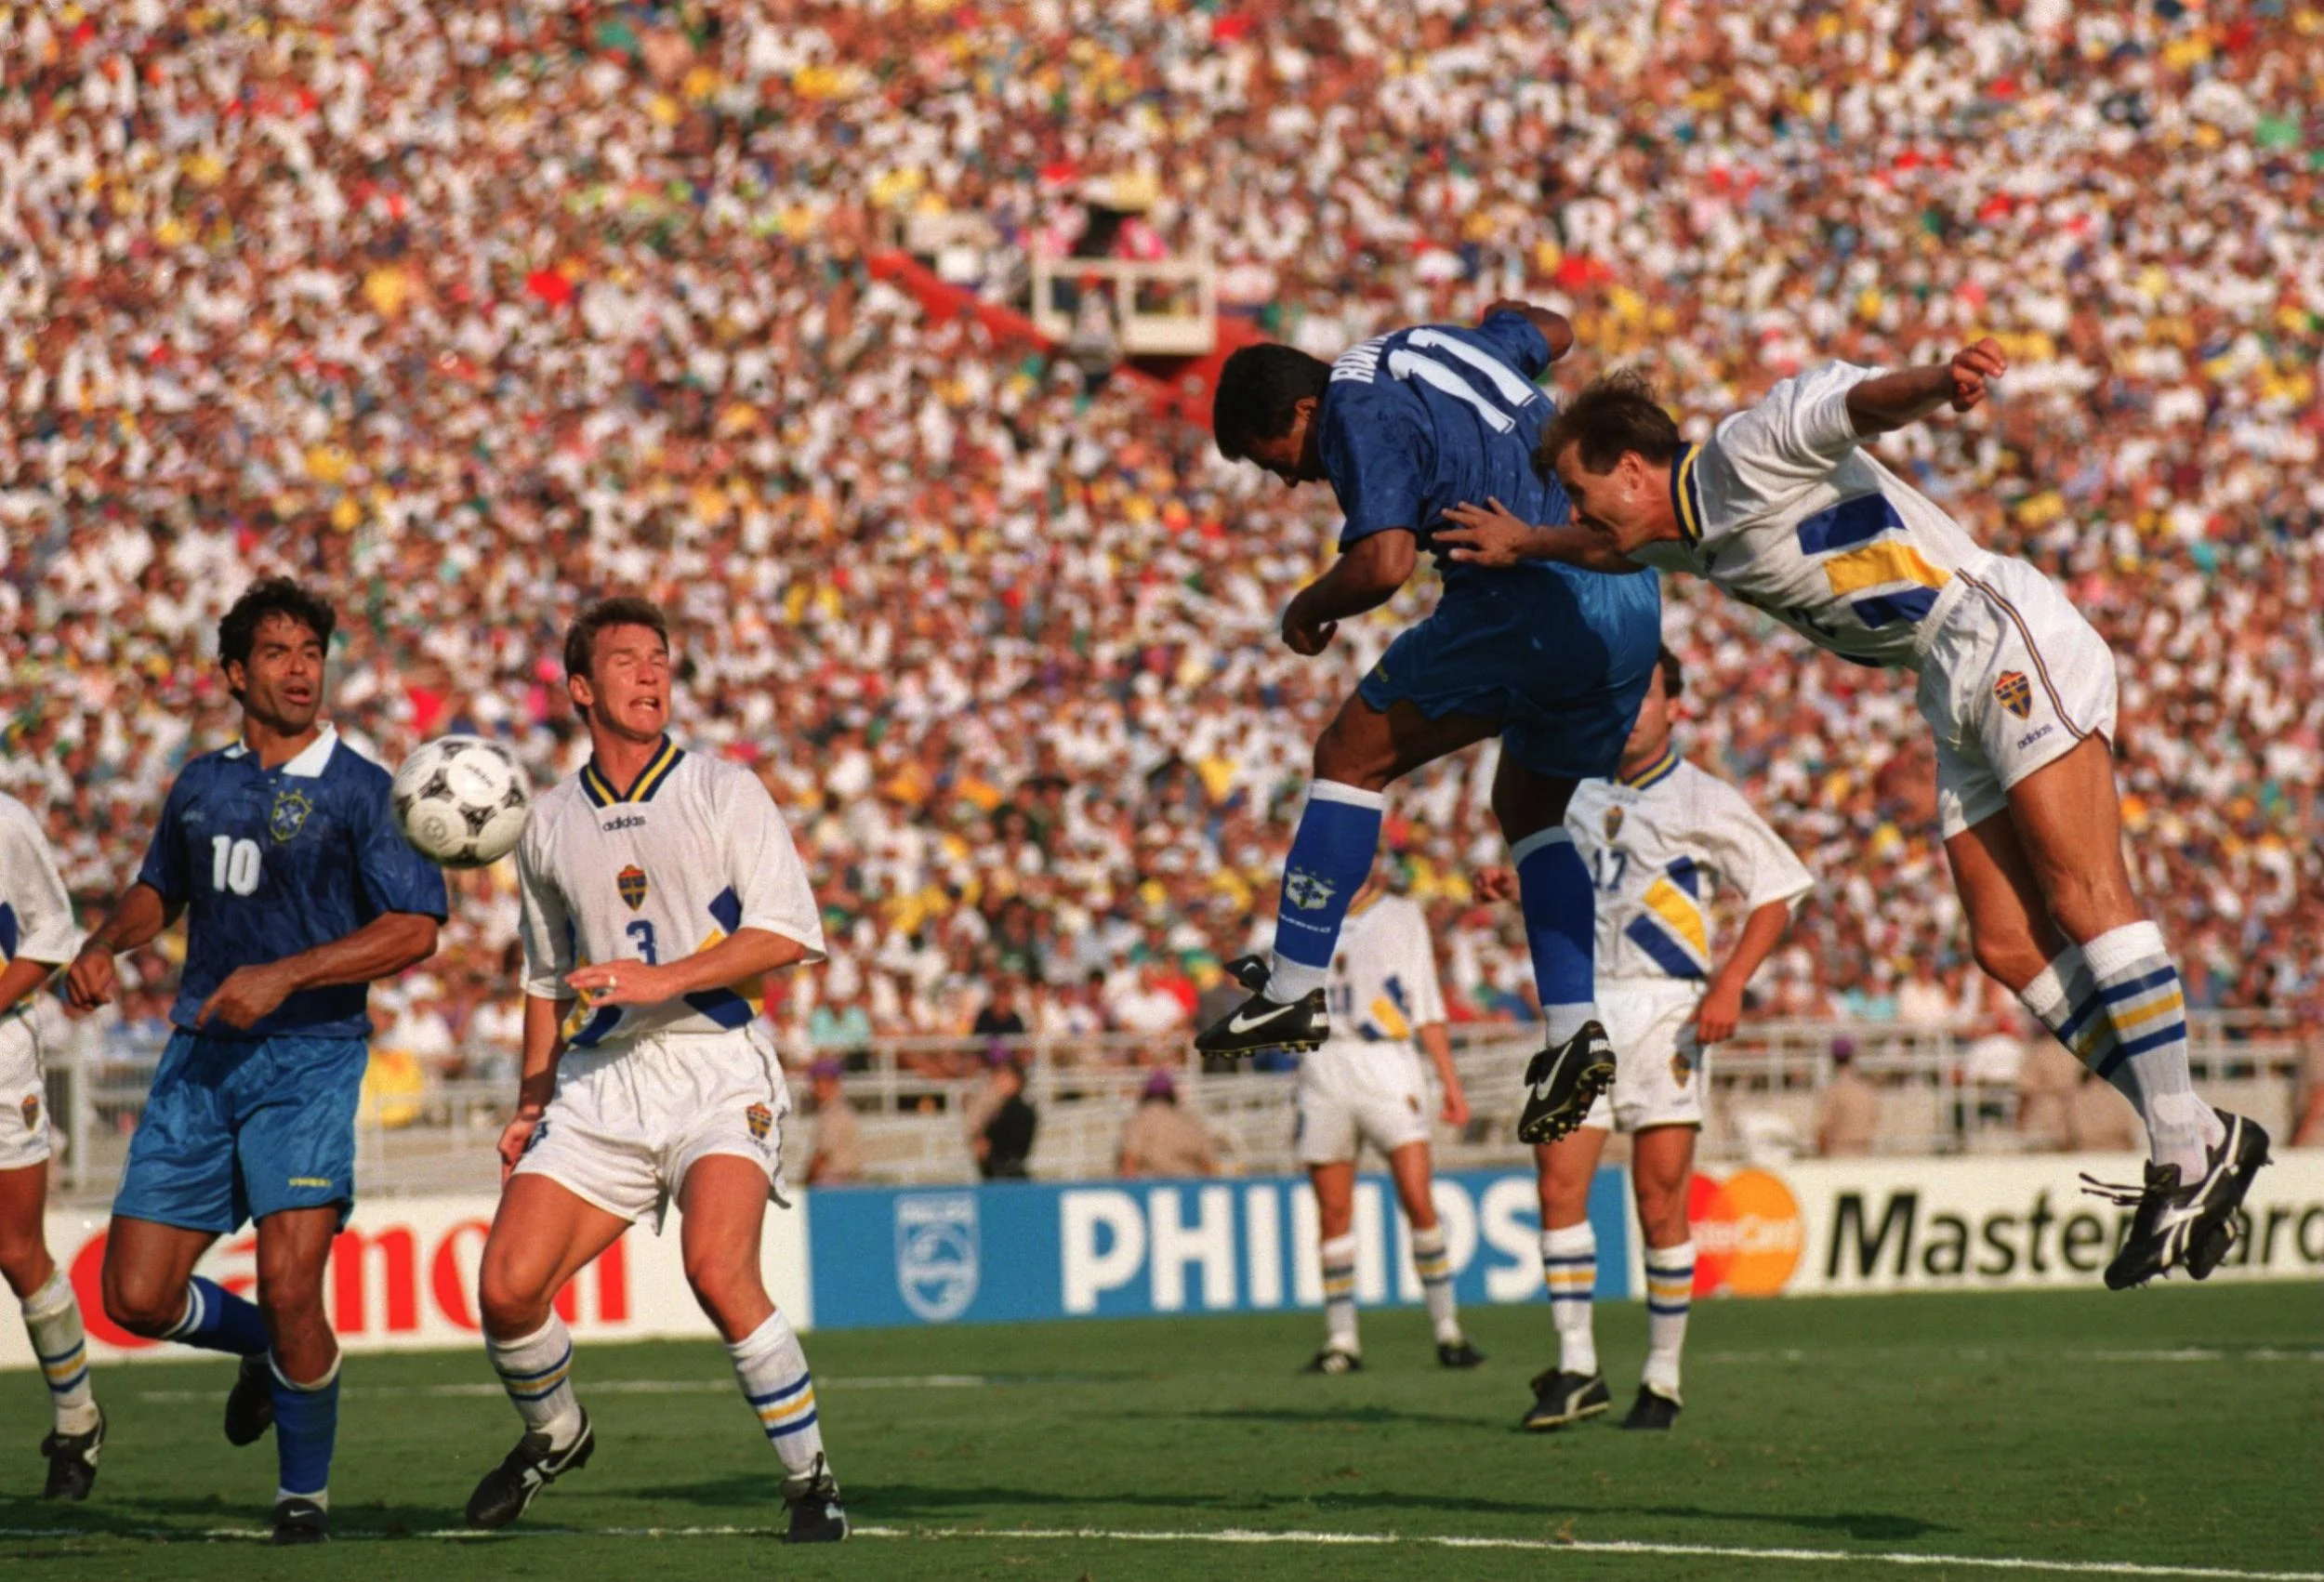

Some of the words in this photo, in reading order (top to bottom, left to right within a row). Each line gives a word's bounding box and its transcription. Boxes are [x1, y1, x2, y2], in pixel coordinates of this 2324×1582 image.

[1388, 328, 1538, 434] 11
[2017, 723, 2053, 750] adidas
[602, 815, 646, 832] adidas
[212, 835, 261, 897] 10
[1592, 847, 1628, 891] 17
[626, 919, 656, 966] 3
[1824, 1190, 2324, 1281] Masterar
